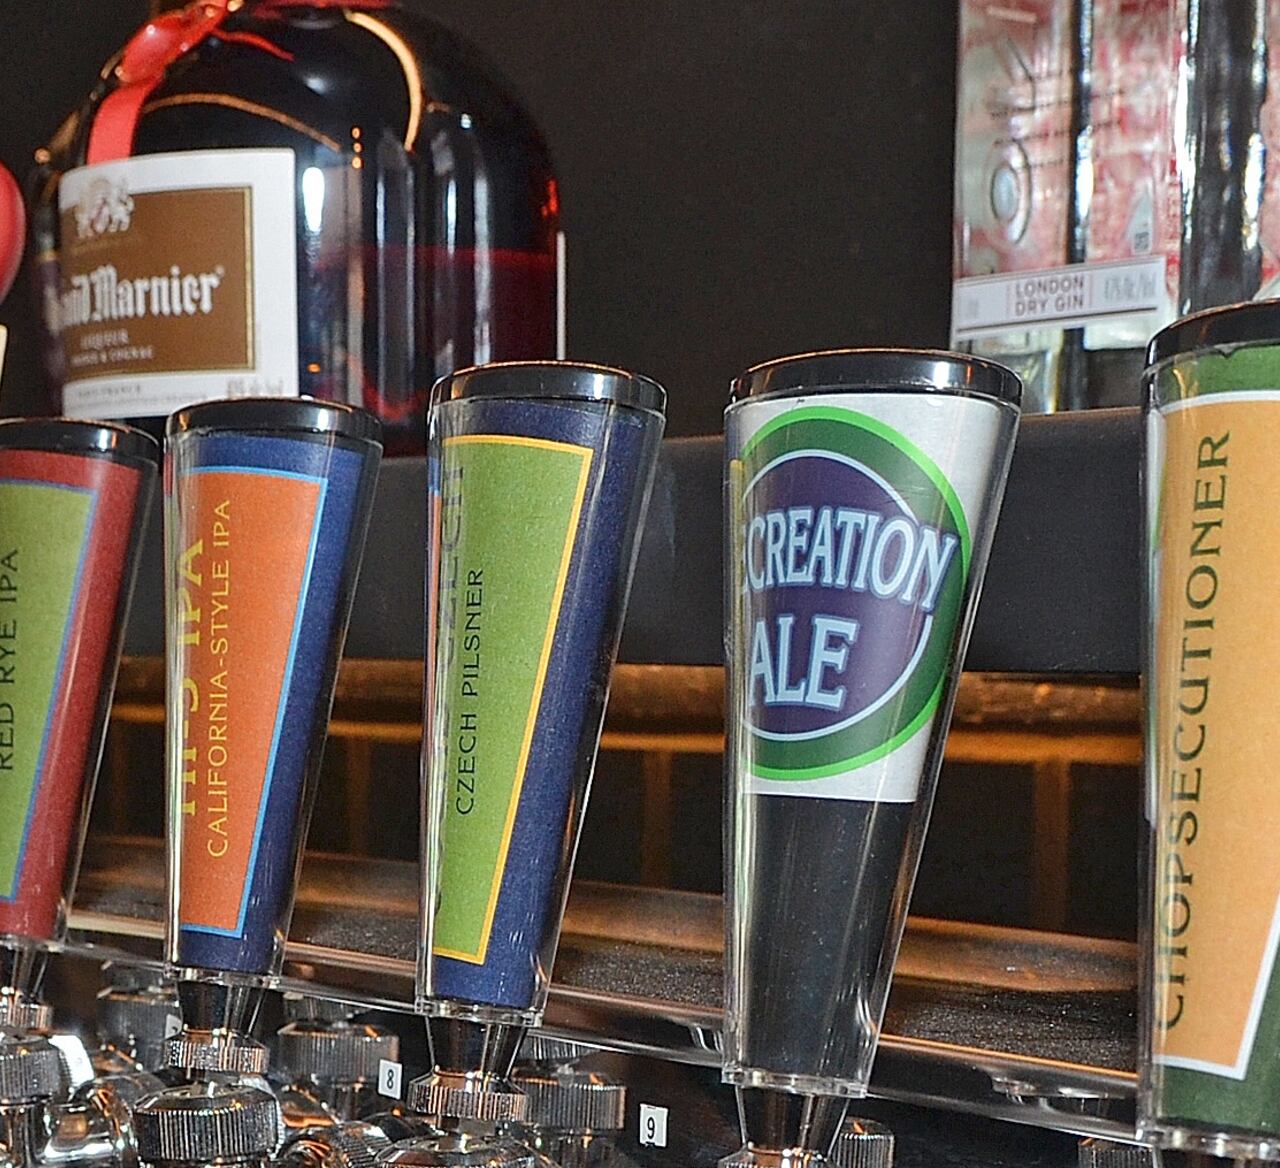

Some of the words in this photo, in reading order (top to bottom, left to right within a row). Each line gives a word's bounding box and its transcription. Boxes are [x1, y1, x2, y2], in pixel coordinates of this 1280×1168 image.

[91, 263, 220, 323] Marnier
[1015, 299, 1048, 317] DRY
[1055, 294, 1084, 312] GIN
[1016, 275, 1084, 297] LONDON
[212, 499, 231, 547] IPA
[0, 549, 18, 603] IPA
[744, 506, 957, 610] CREATION
[461, 569, 484, 698] PILSNER
[749, 614, 859, 710] ALE
[206, 559, 230, 858] CALIFORNIA-STYLE
[455, 712, 477, 816] CZECH
[386, 1068, 394, 1090] 8
[646, 1115, 656, 1140] 9
